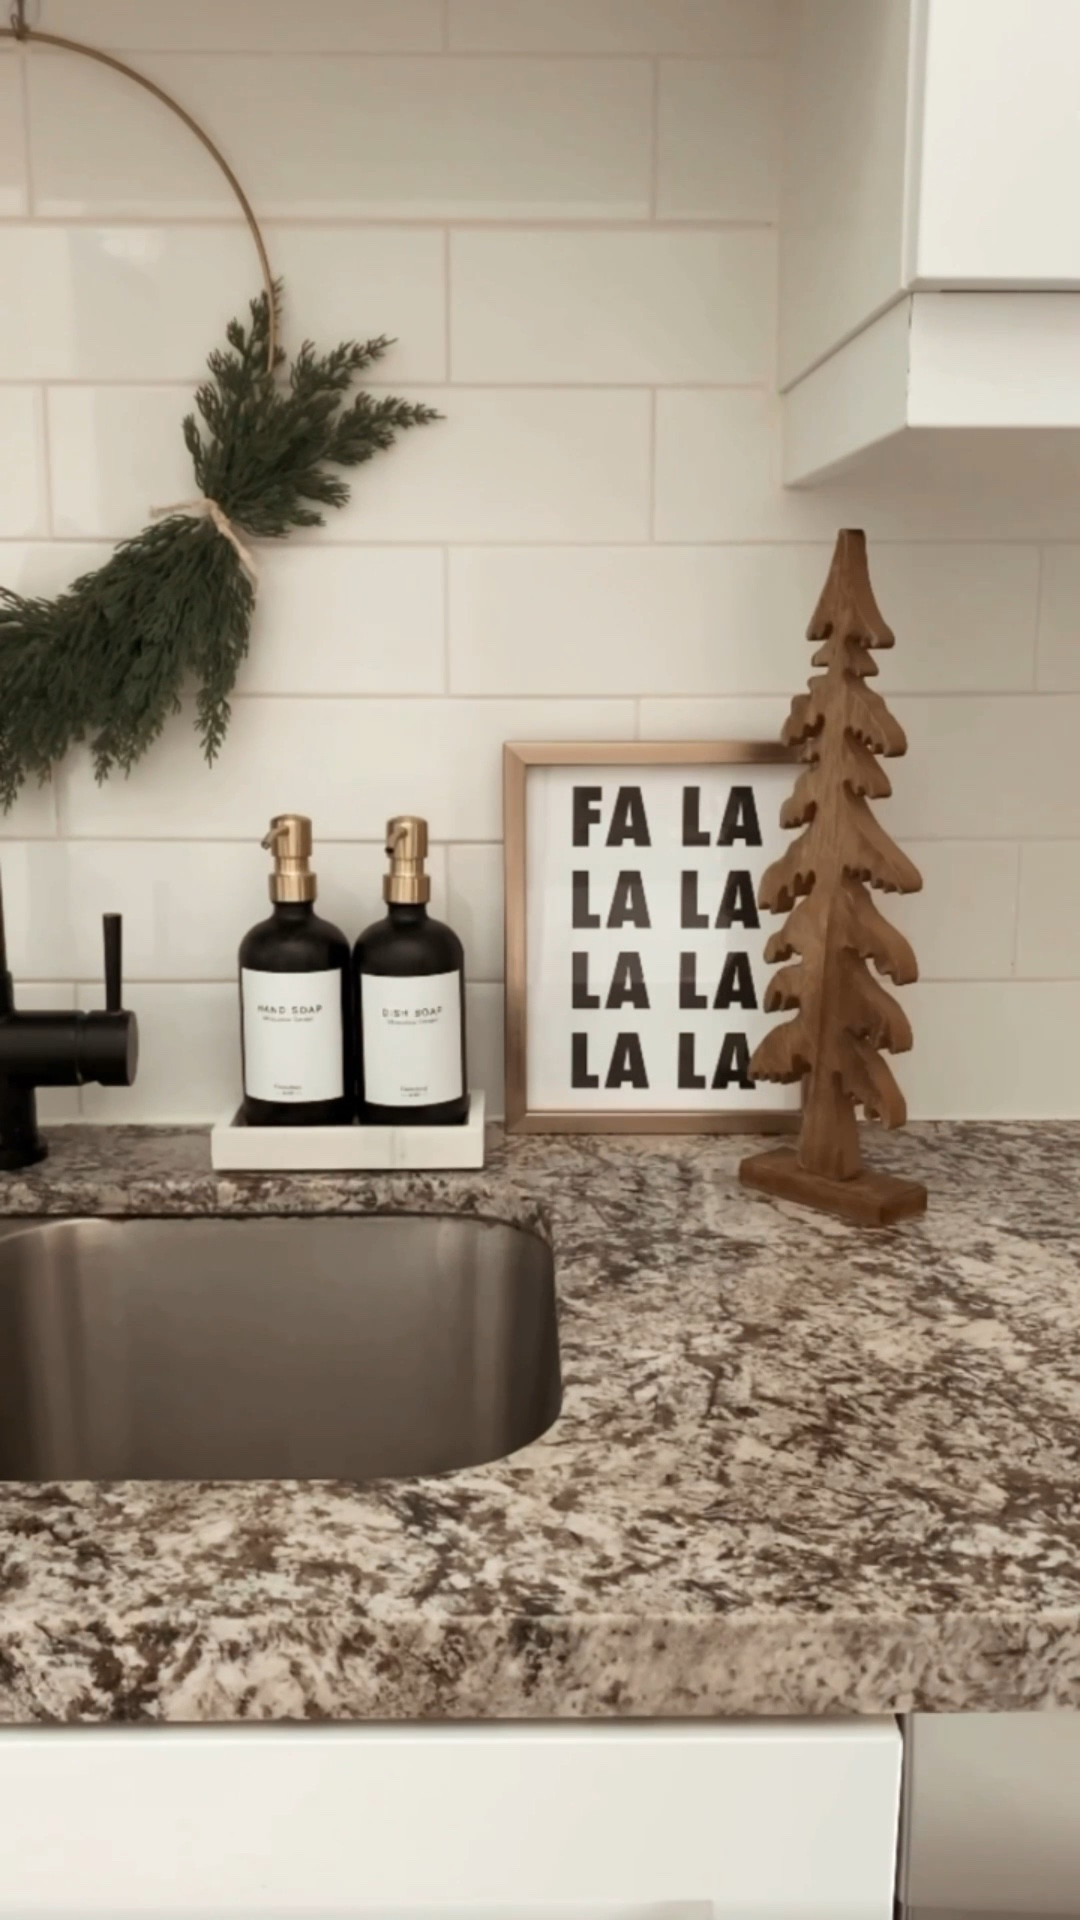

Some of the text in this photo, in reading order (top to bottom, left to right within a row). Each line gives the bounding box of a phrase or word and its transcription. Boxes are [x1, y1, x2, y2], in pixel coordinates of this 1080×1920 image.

[571, 786, 763, 847] FA LA
[571, 870, 761, 929] LA LA
[571, 951, 758, 1009] LA LA
[257, 1004, 323, 1015] HAND SOAP
[382, 1006, 443, 1018] DISH SOAP
[570, 1032, 756, 1089] LA LA
